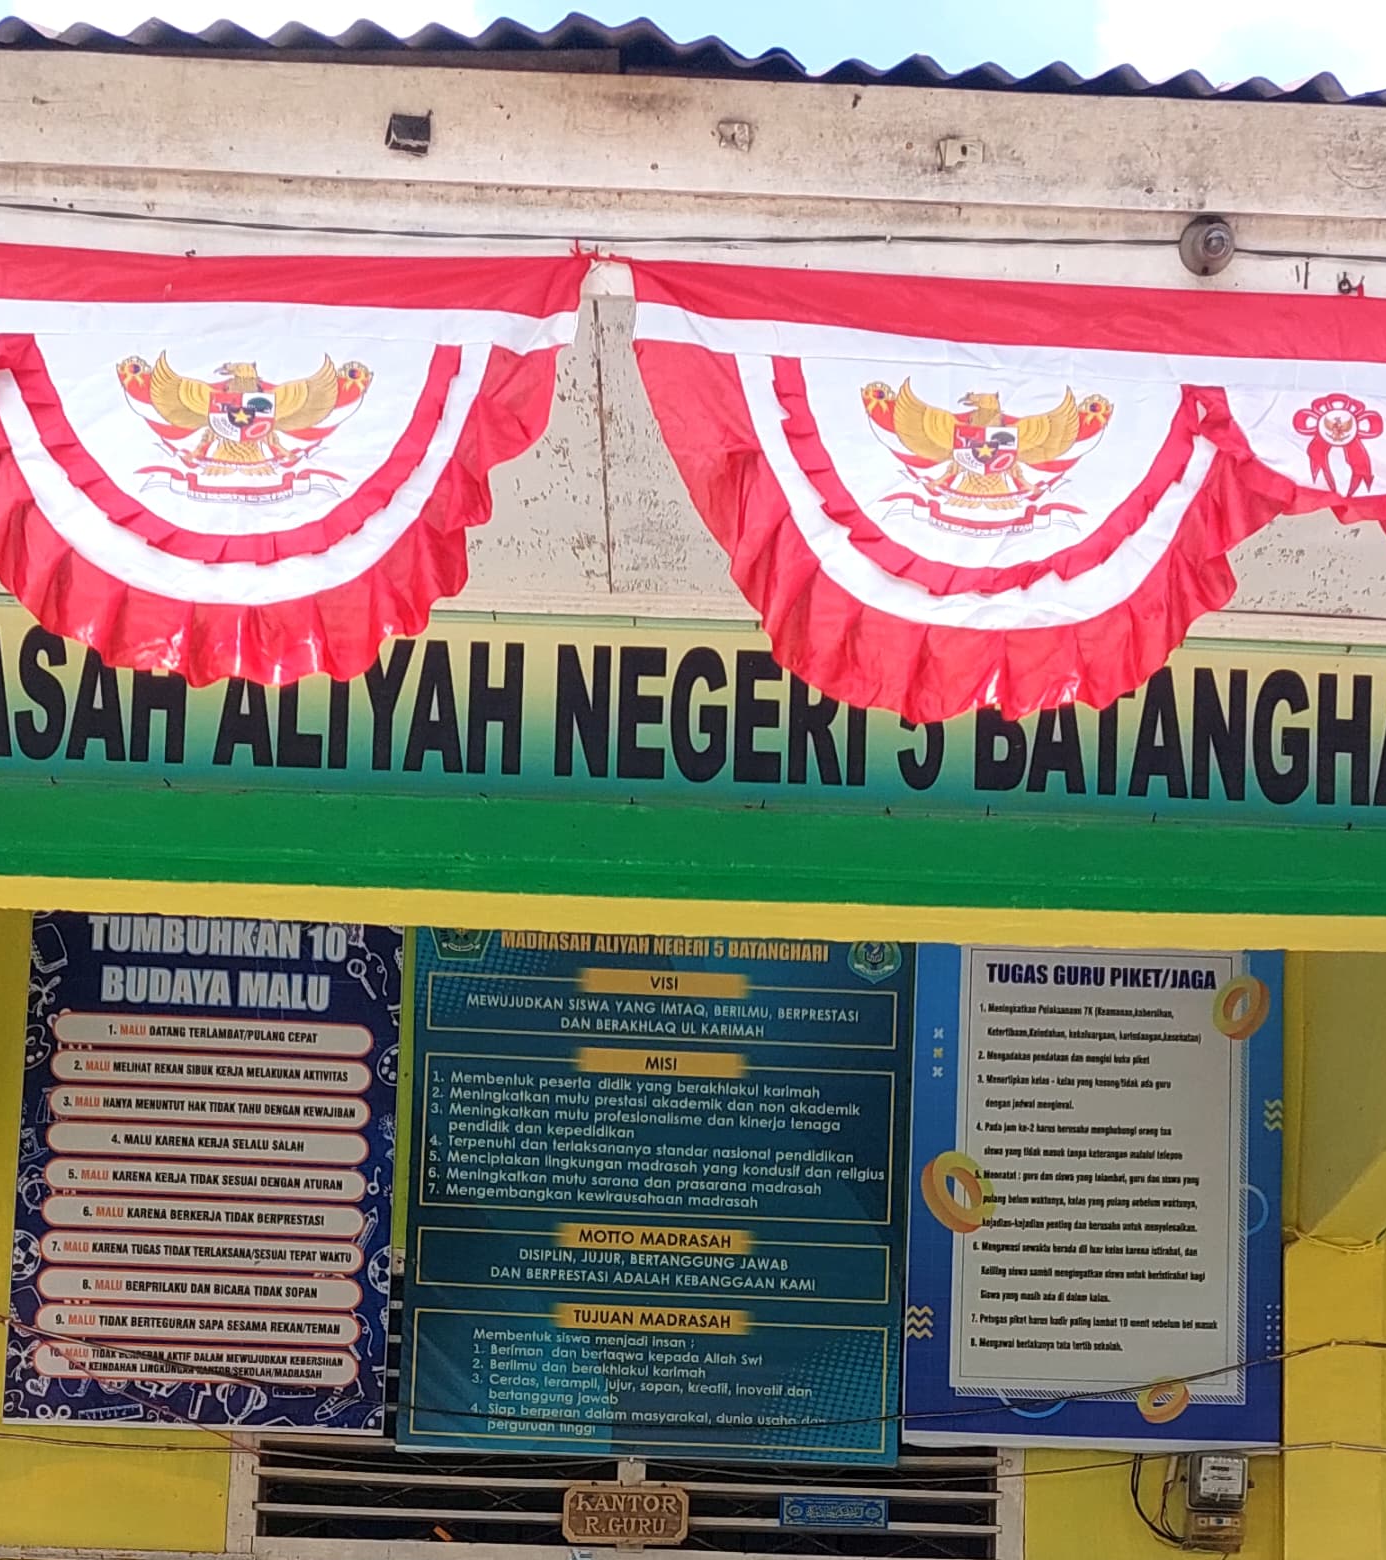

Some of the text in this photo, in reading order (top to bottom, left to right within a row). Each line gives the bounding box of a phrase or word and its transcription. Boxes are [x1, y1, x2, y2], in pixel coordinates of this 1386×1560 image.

[213, 638, 525, 776] ALIYAH
[554, 642, 867, 787] NEGERI
[88, 915, 348, 963] TUMBUHKAN 10
[500, 930, 829, 962] MADRASAH ALIYAH NEGERI 5 BATANGHARI
[650, 975, 678, 991] VISI
[986, 963, 1217, 990] TUGAS GURU PIKET/JAGA
[100, 964, 332, 1013] BUDAYA MALU
[466, 993, 859, 1023] MEWUJUDKAN SISWA YANG IMTAQ, BERILMU, BERPRESTASI
[108, 1025, 318, 1044] 1. MALU DATANG TERLAMBAT/PULANG CEPAT
[560, 1016, 765, 1038] DAN BERAKHLAQ UL KARIMAH
[74, 1060, 348, 1082] 2. MALU MELIHAT REKAN SIBUK KERJA MELAKUKAN AKTIVITAS
[645, 1055, 678, 1072] MISI
[432, 1071, 820, 1099] 1. Membentuk peserta didik yang berakhlakul karimah
[111, 1134, 304, 1152] 4. MALU KARENA KERJA SELALU SALAH
[68, 1169, 343, 1191] 5. MALU KARENA KERJA TIDAK SESUAI DENGAN ATURAN
[82, 1206, 325, 1226] 6. MALU KARENA BERKERJA TIDAK BERPRESTASI
[578, 1228, 732, 1249] MOTTO MADRASAH
[52, 1241, 352, 1264] 7. MALU KARENA TUGAS TIDAK TERLAKSANA/SESUAI TEPAT WAKTU
[519, 1248, 789, 1271] DISIPLIN, JUJUR, BERTANGGUNG JAWAB
[82, 1279, 318, 1298] 8. MALU BERPRILAKU DAN BICARA TIDAK SOPAN
[490, 1266, 816, 1291] DAN BERPRESTASI ADALAH KEBANGGAAN KAMI
[55, 1314, 341, 1335] 9. MALU TIDAK BERTEGURAN SAPA SESAMA REKAN/TEMAN
[573, 1309, 732, 1329] TUJUAN MADRASAH
[575, 1493, 678, 1514] KANTOR
[585, 1516, 666, 1536] R.GURU
